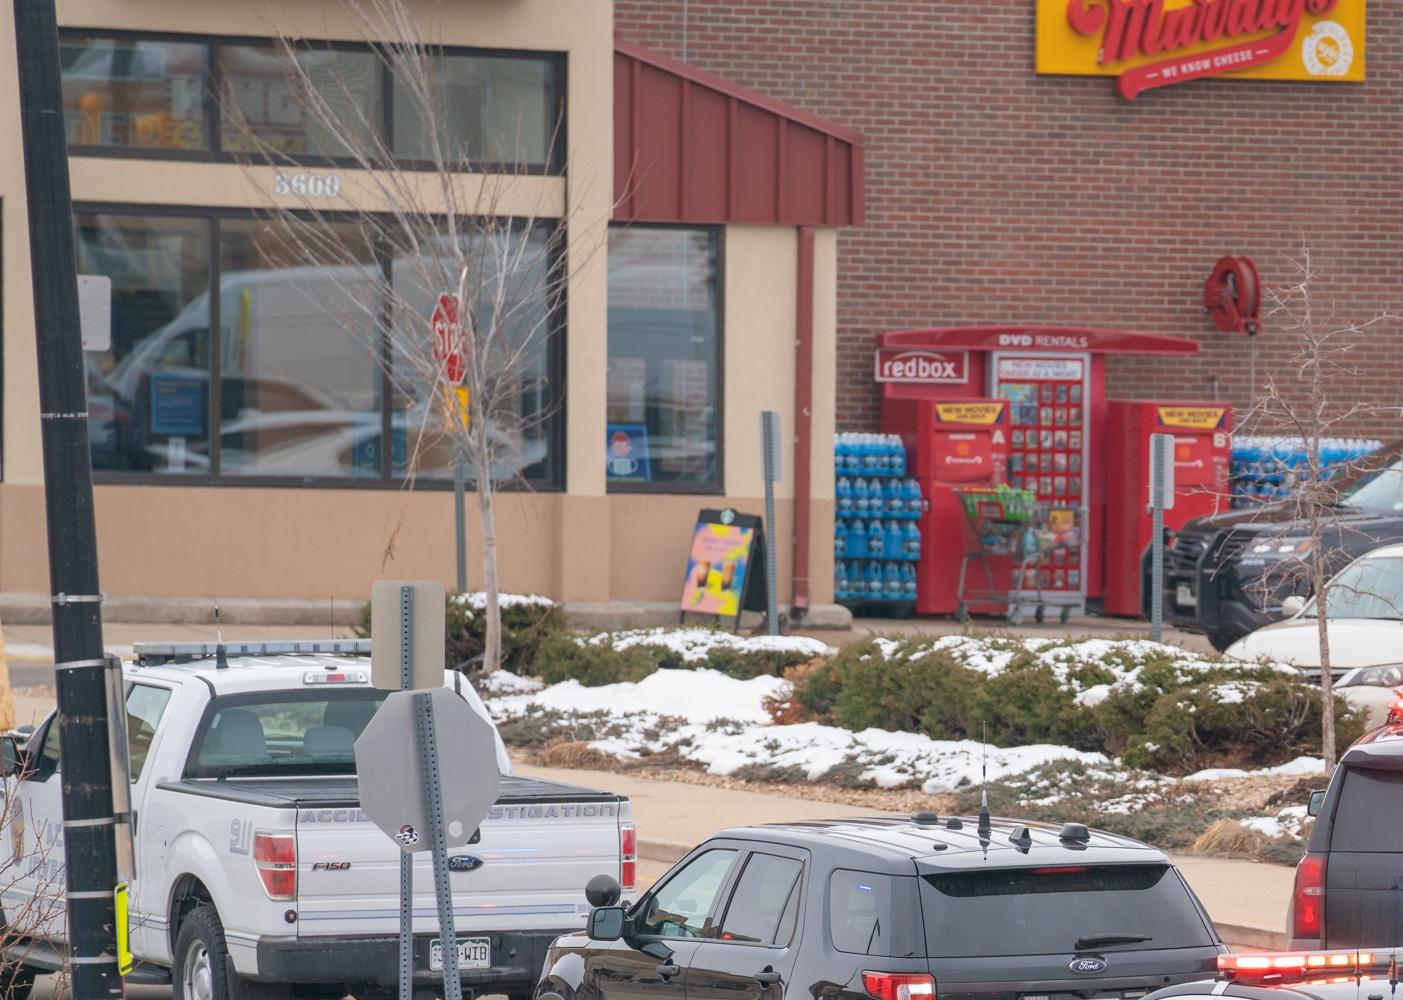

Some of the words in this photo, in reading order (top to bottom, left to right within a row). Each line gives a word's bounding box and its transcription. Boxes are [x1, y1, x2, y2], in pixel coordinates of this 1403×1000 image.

[1162, 66, 1177, 78] WE
[1180, 59, 1211, 76] KNOW
[1214, 50, 1253, 68] CHEESE
[1000, 334, 1032, 346] DVD
[1035, 336, 1088, 348] RENTALS
[883, 357, 956, 378] redbox
[992, 430, 1005, 444] A
[1213, 433, 1227, 448] B
[300, 809, 370, 823] ACCID
[488, 804, 617, 820] STIGATION
[230, 819, 253, 850] 911
[449, 855, 476, 870] Ford
[1078, 960, 1099, 971] Ford
